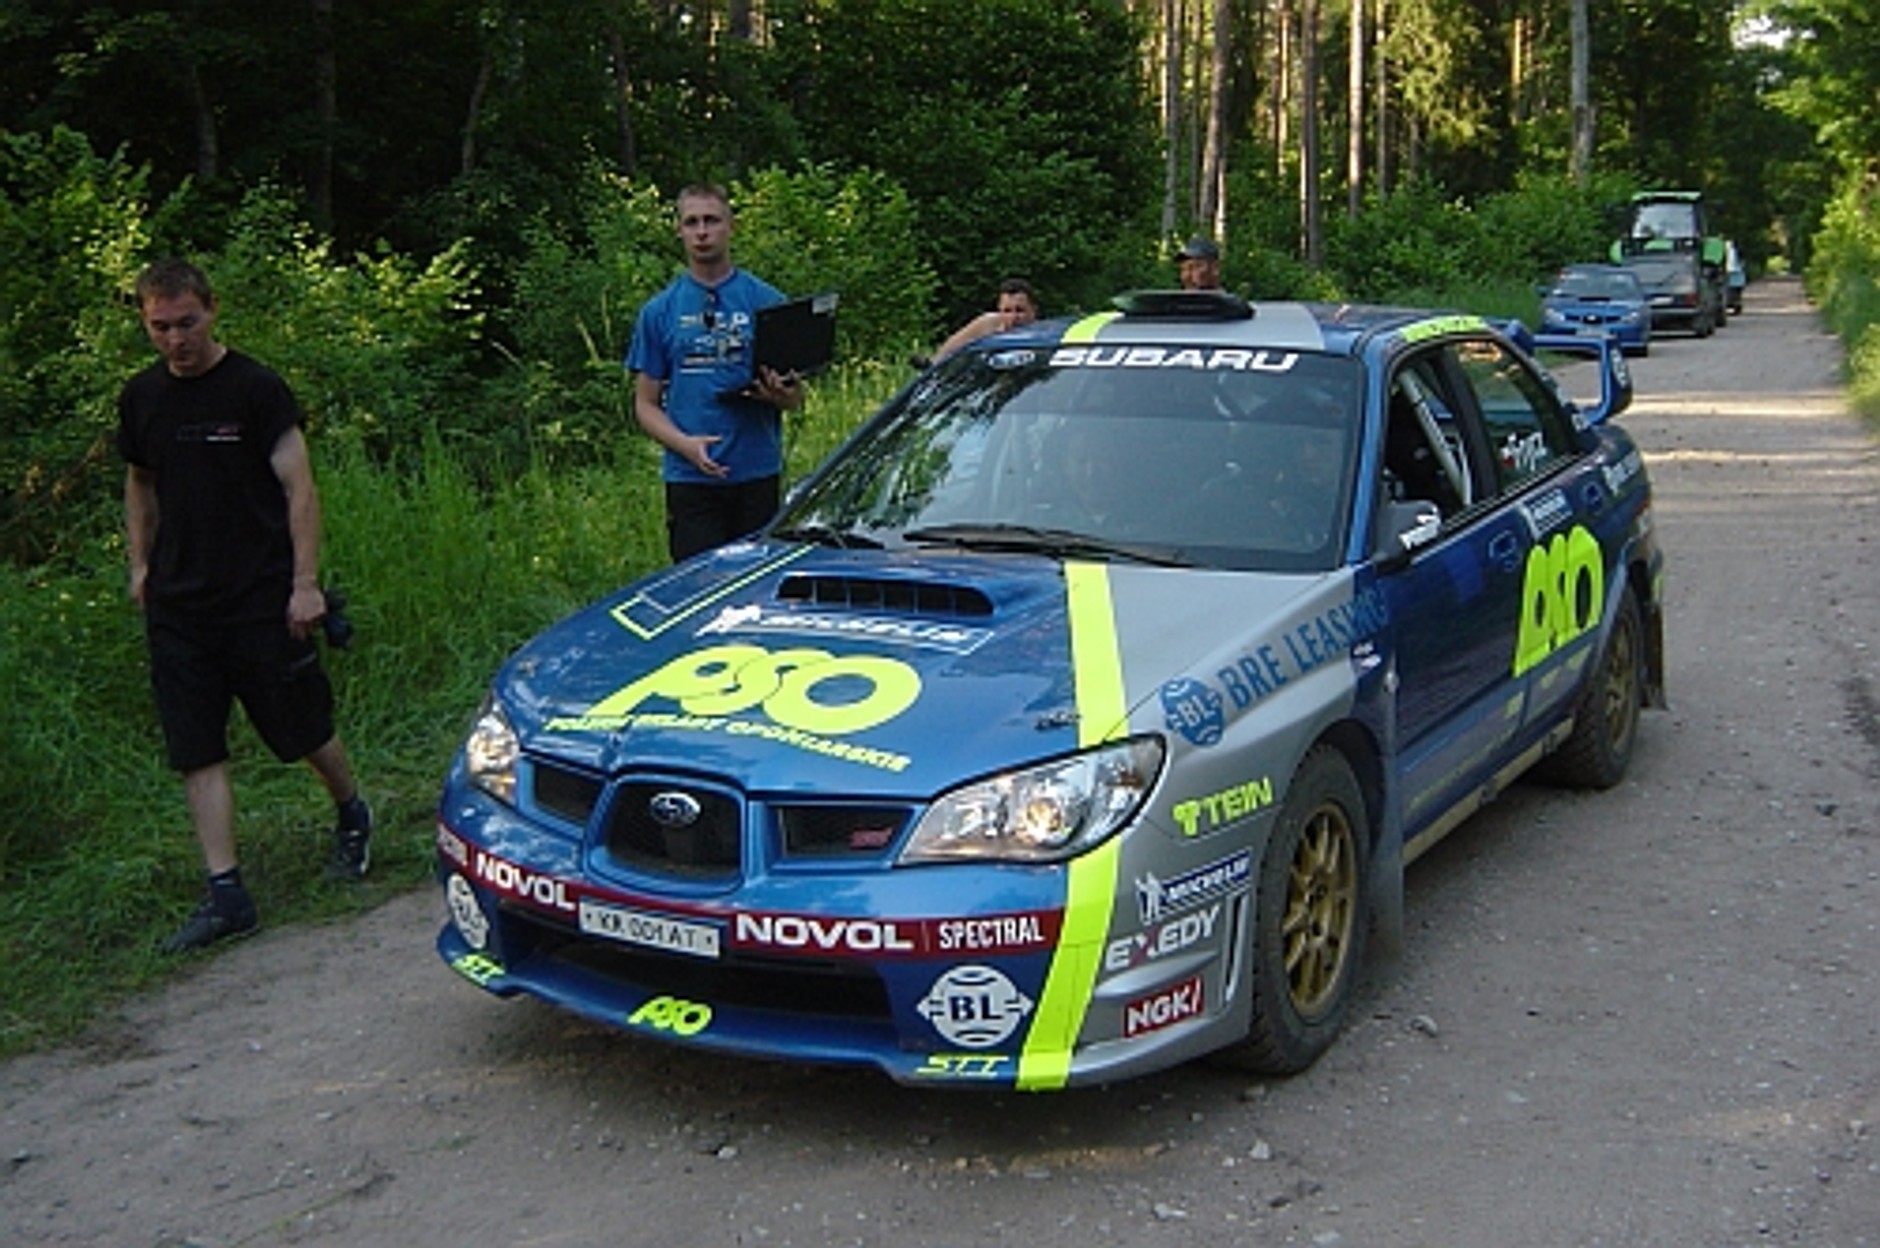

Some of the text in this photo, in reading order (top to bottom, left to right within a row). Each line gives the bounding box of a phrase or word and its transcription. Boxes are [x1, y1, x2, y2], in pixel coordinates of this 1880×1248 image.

[1049, 348, 1299, 372] SUBARU
[582, 645, 922, 735] PSO
[1218, 644, 1288, 712] BRE
[1203, 777, 1273, 826] TEIN
[476, 851, 577, 911] NOVOL
[735, 912, 1045, 950] NOVOL SPECTRAL
[1104, 904, 1220, 972] EXEDY
[951, 994, 1002, 1021] BL
[1127, 986, 1191, 1033] NGK
